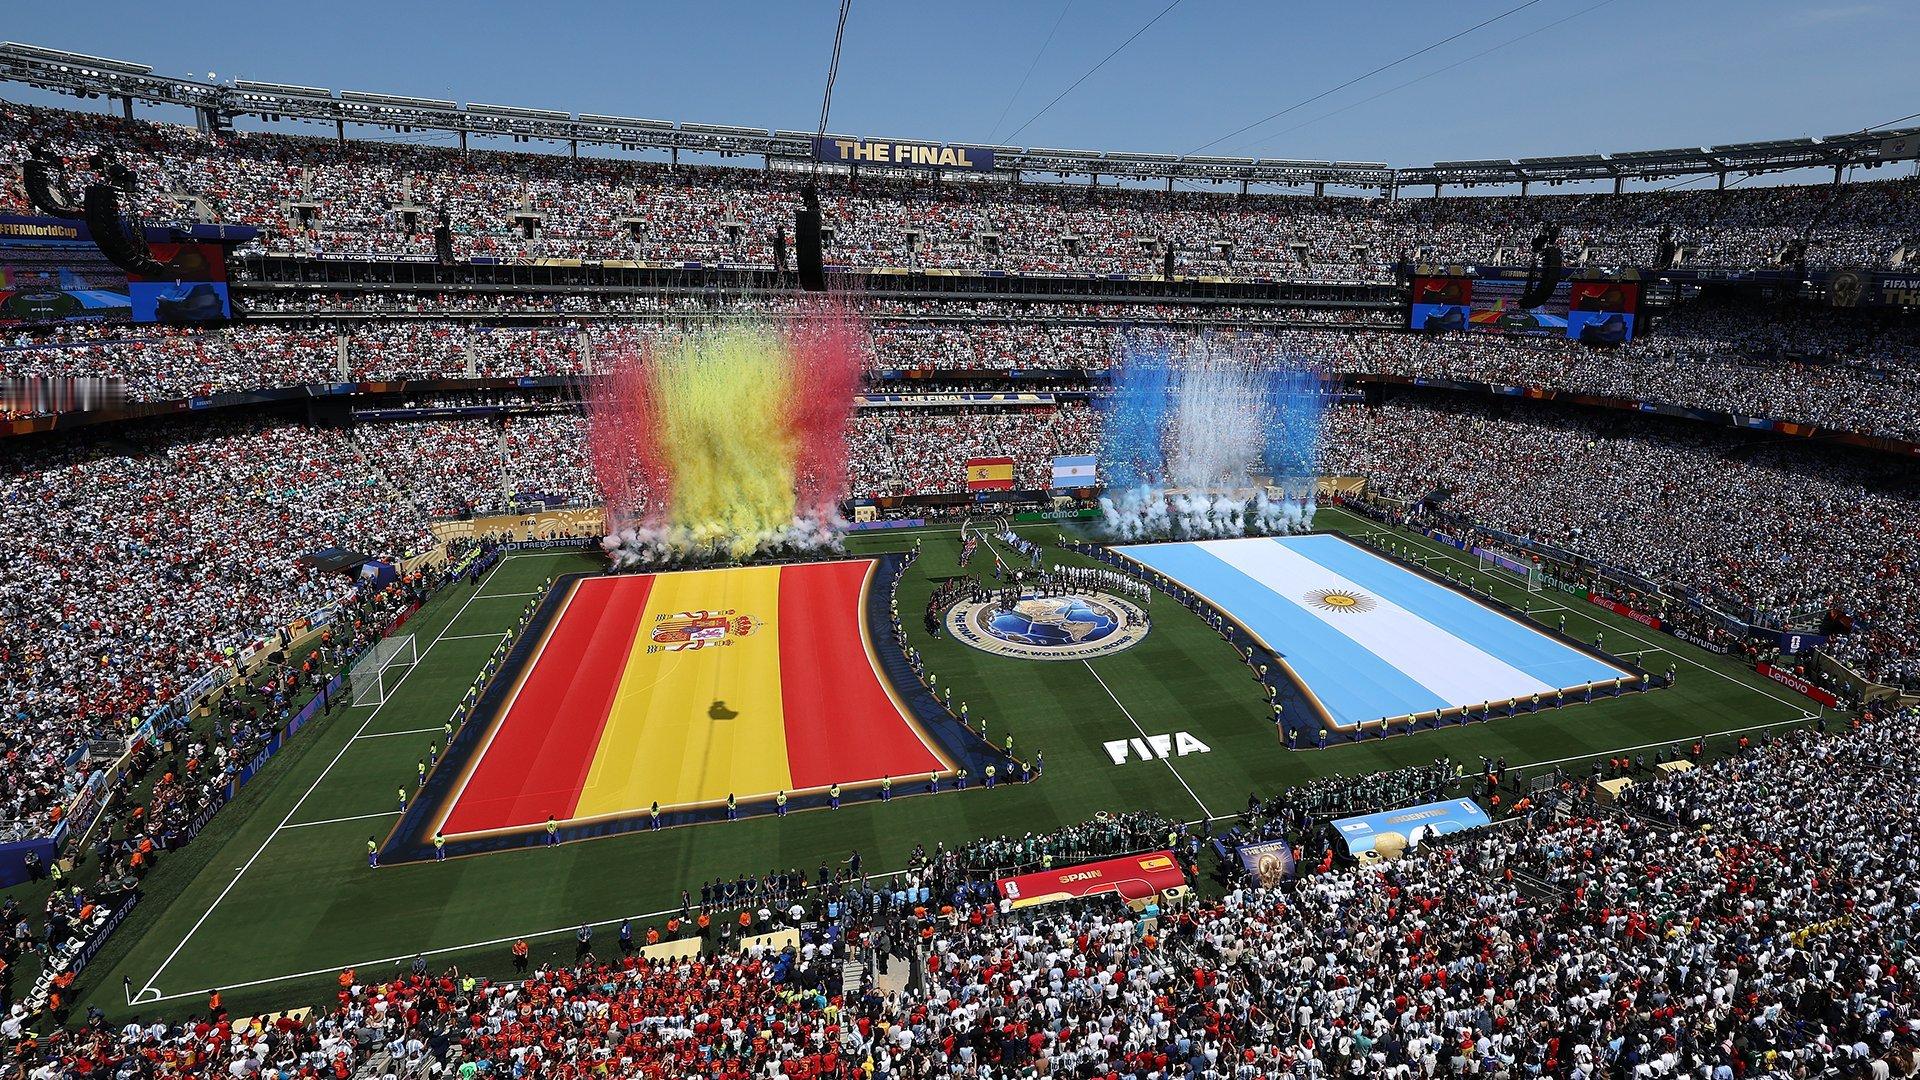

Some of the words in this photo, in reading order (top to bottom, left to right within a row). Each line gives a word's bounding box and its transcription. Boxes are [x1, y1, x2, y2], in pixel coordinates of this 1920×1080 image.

[835, 140, 890, 162] THE
[895, 145, 973, 168] FINAL
[1883, 280, 1907, 288] FIFA
[520, 519, 537, 527] FIFA
[1041, 510, 1079, 520] aramco
[1441, 535, 1456, 547] VISA
[1537, 572, 1575, 594] aramco
[954, 611, 967, 624] THE
[957, 624, 982, 643] FINAL
[1000, 646, 1027, 656] FIFA
[1077, 647, 1100, 656] CUP
[1100, 635, 1133, 651] 2026
[1689, 635, 1728, 655] HYUNDAI
[1768, 668, 1808, 694] Lenovo
[1102, 731, 1211, 765] FIFA
[249, 749, 270, 776] VISA
[187, 799, 224, 842] AIRWAYS
[1260, 844, 1285, 853] FINAL
[1058, 869, 1103, 884] SPAIN
[73, 953, 86, 975] DI
